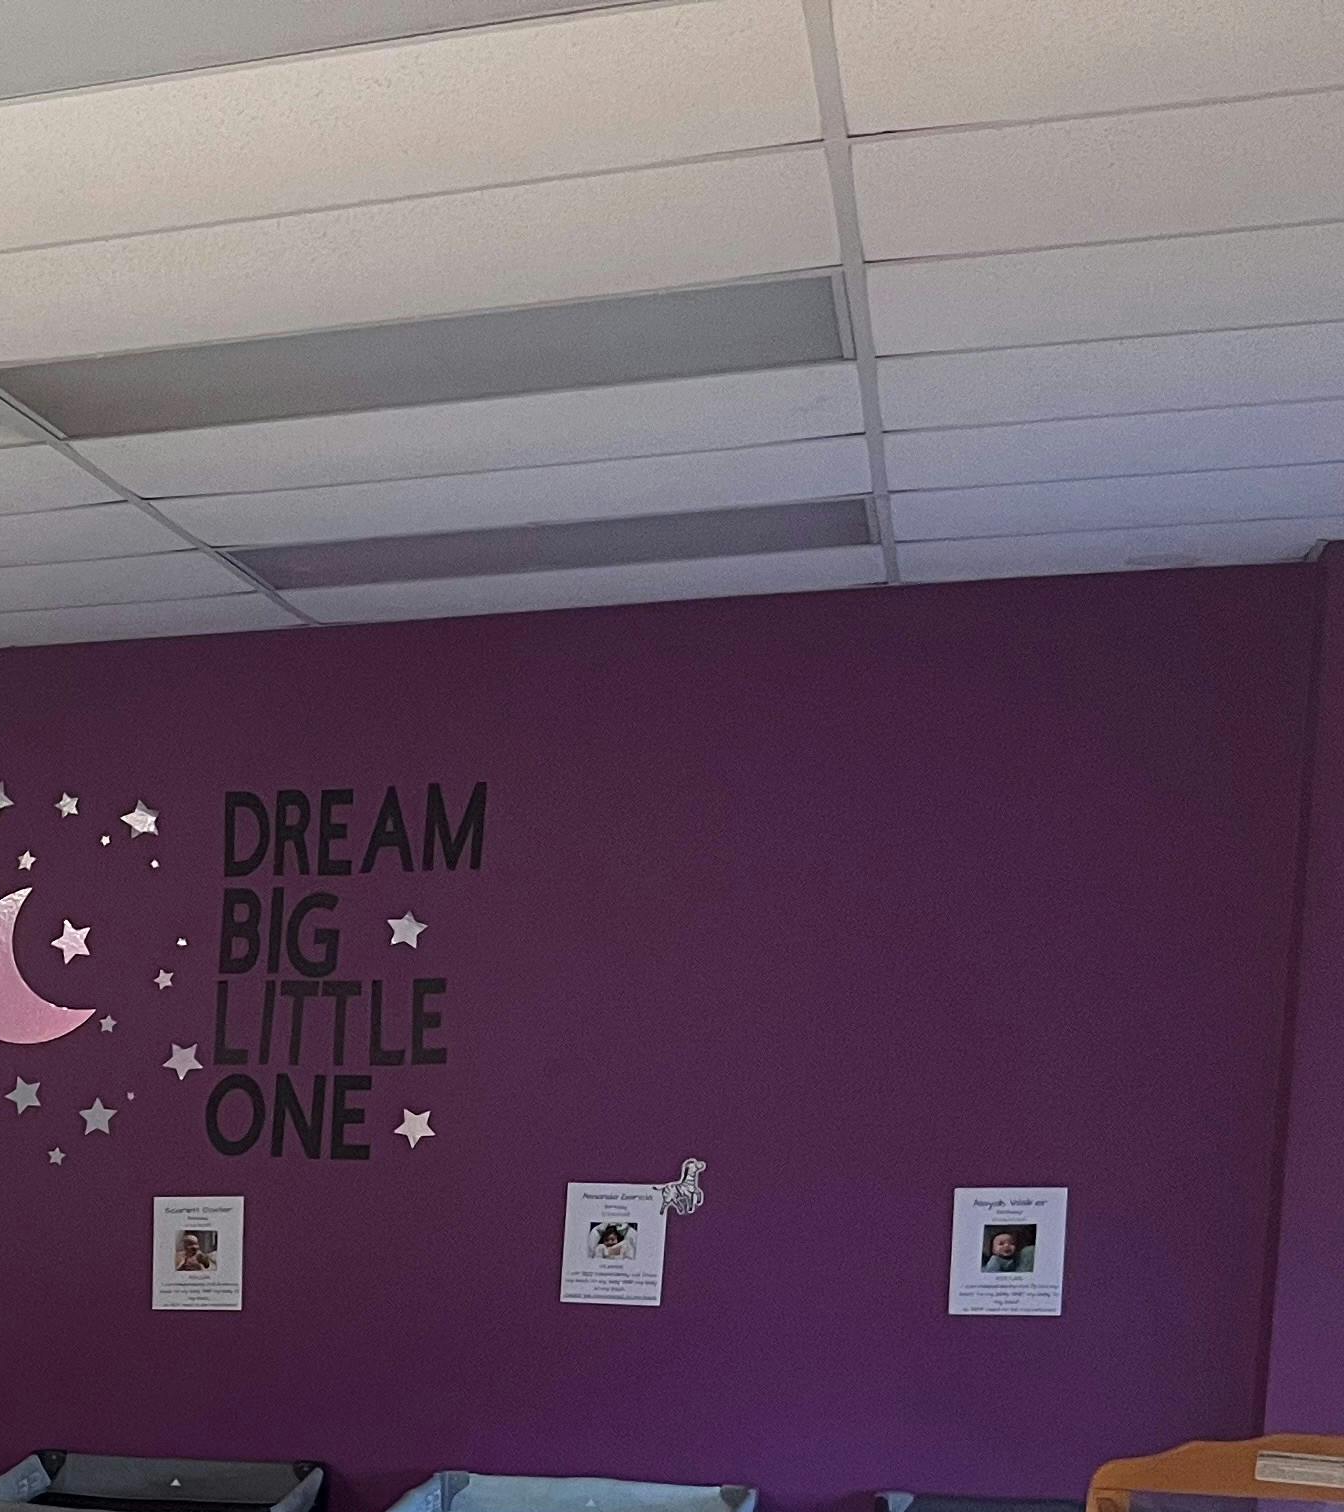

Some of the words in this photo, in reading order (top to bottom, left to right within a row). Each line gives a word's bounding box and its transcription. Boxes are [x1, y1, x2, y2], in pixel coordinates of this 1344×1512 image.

[224, 781, 487, 877] DREAM
[219, 887, 340, 977] BIG
[213, 977, 447, 1066] LITTLE
[205, 1072, 372, 1160] ONE
